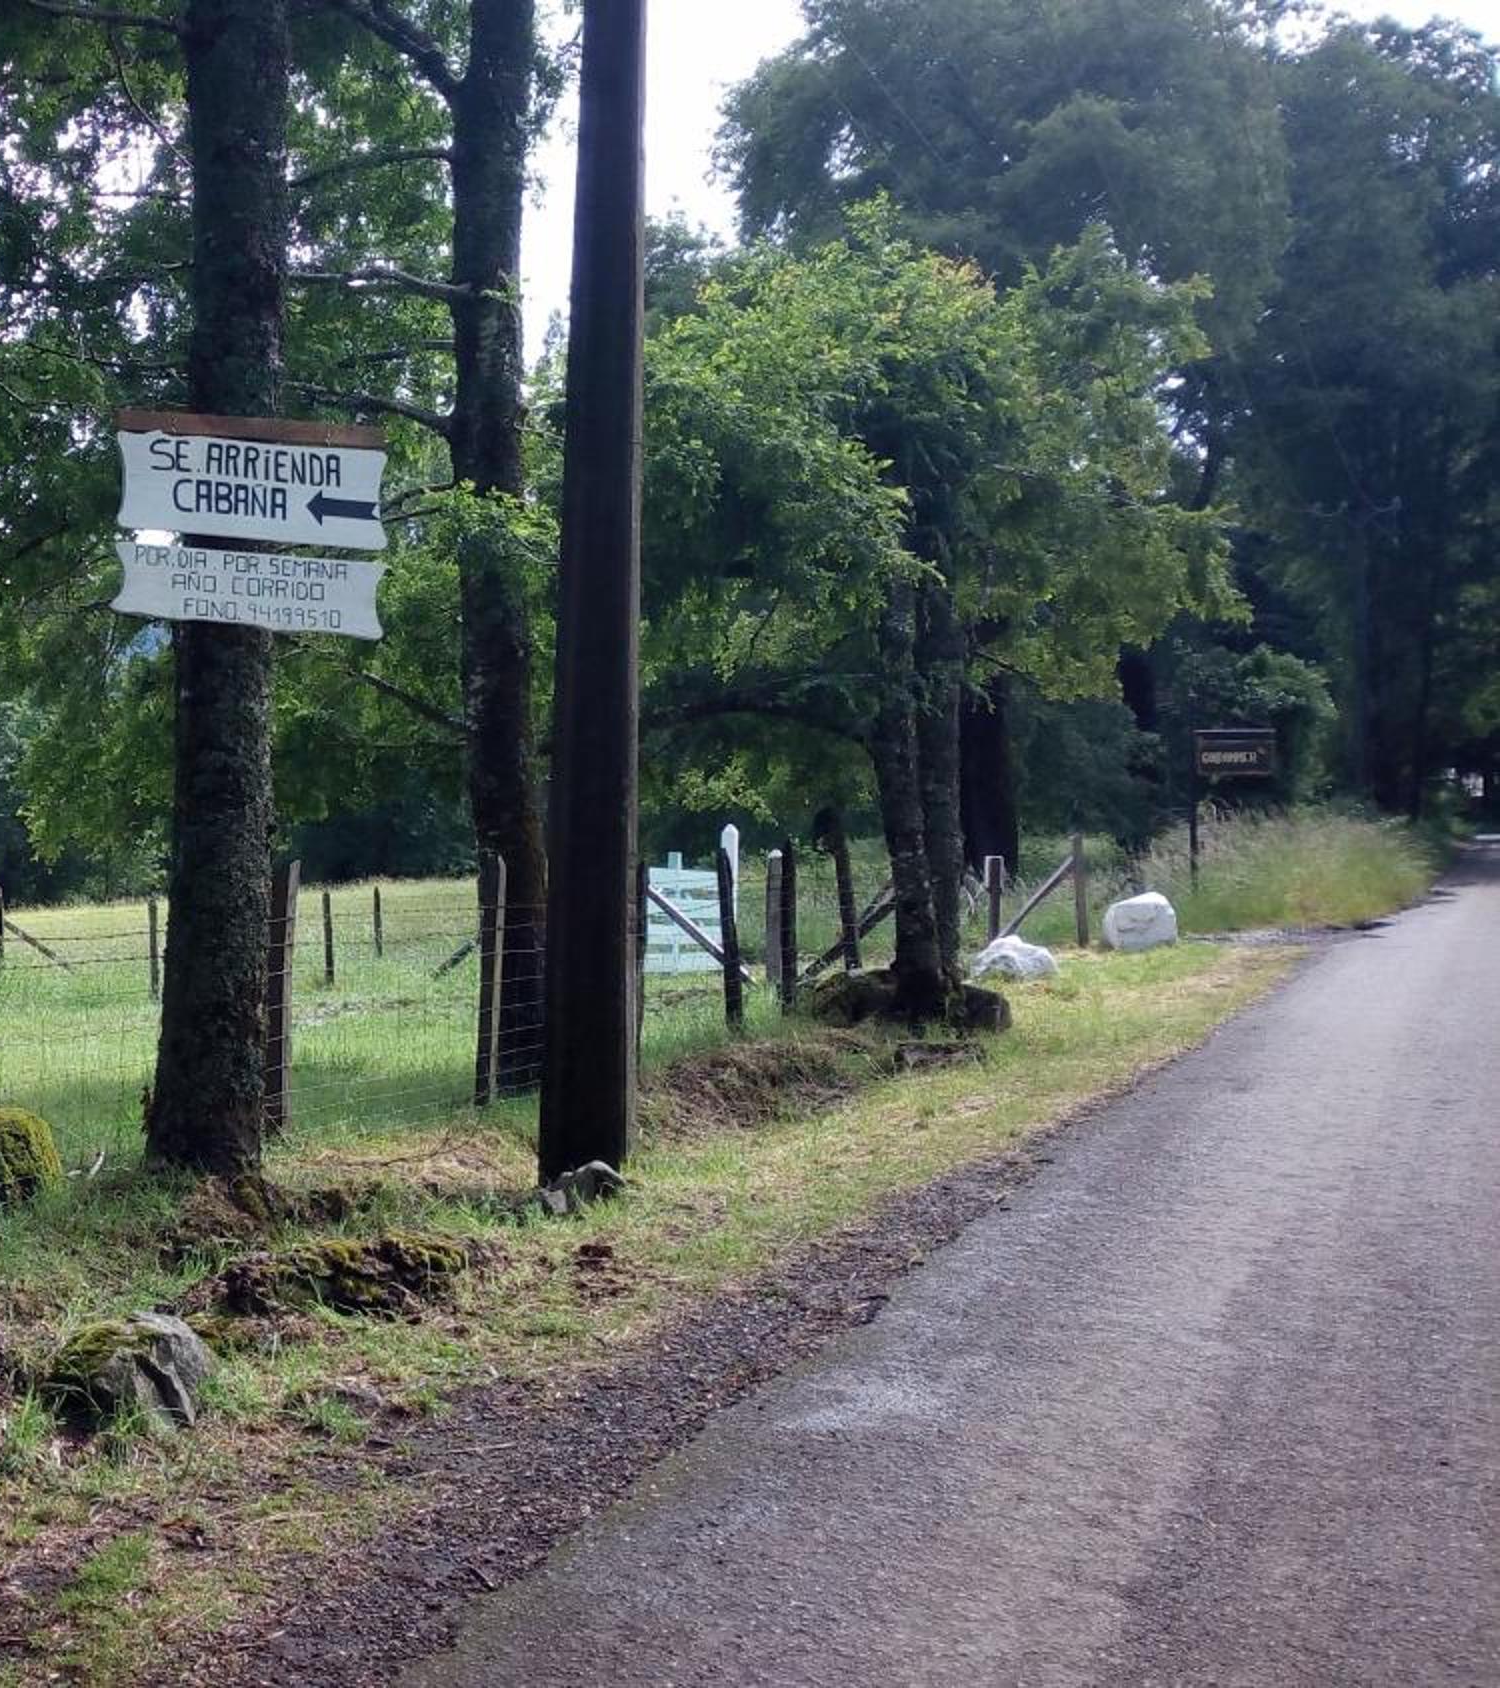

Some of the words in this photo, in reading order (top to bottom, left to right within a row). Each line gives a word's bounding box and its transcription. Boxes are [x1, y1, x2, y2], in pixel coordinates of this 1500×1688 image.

[173, 478, 287, 521] CABAÑA
[269, 558, 348, 582] SEMANA
[231, 576, 325, 601] CORRIDO
